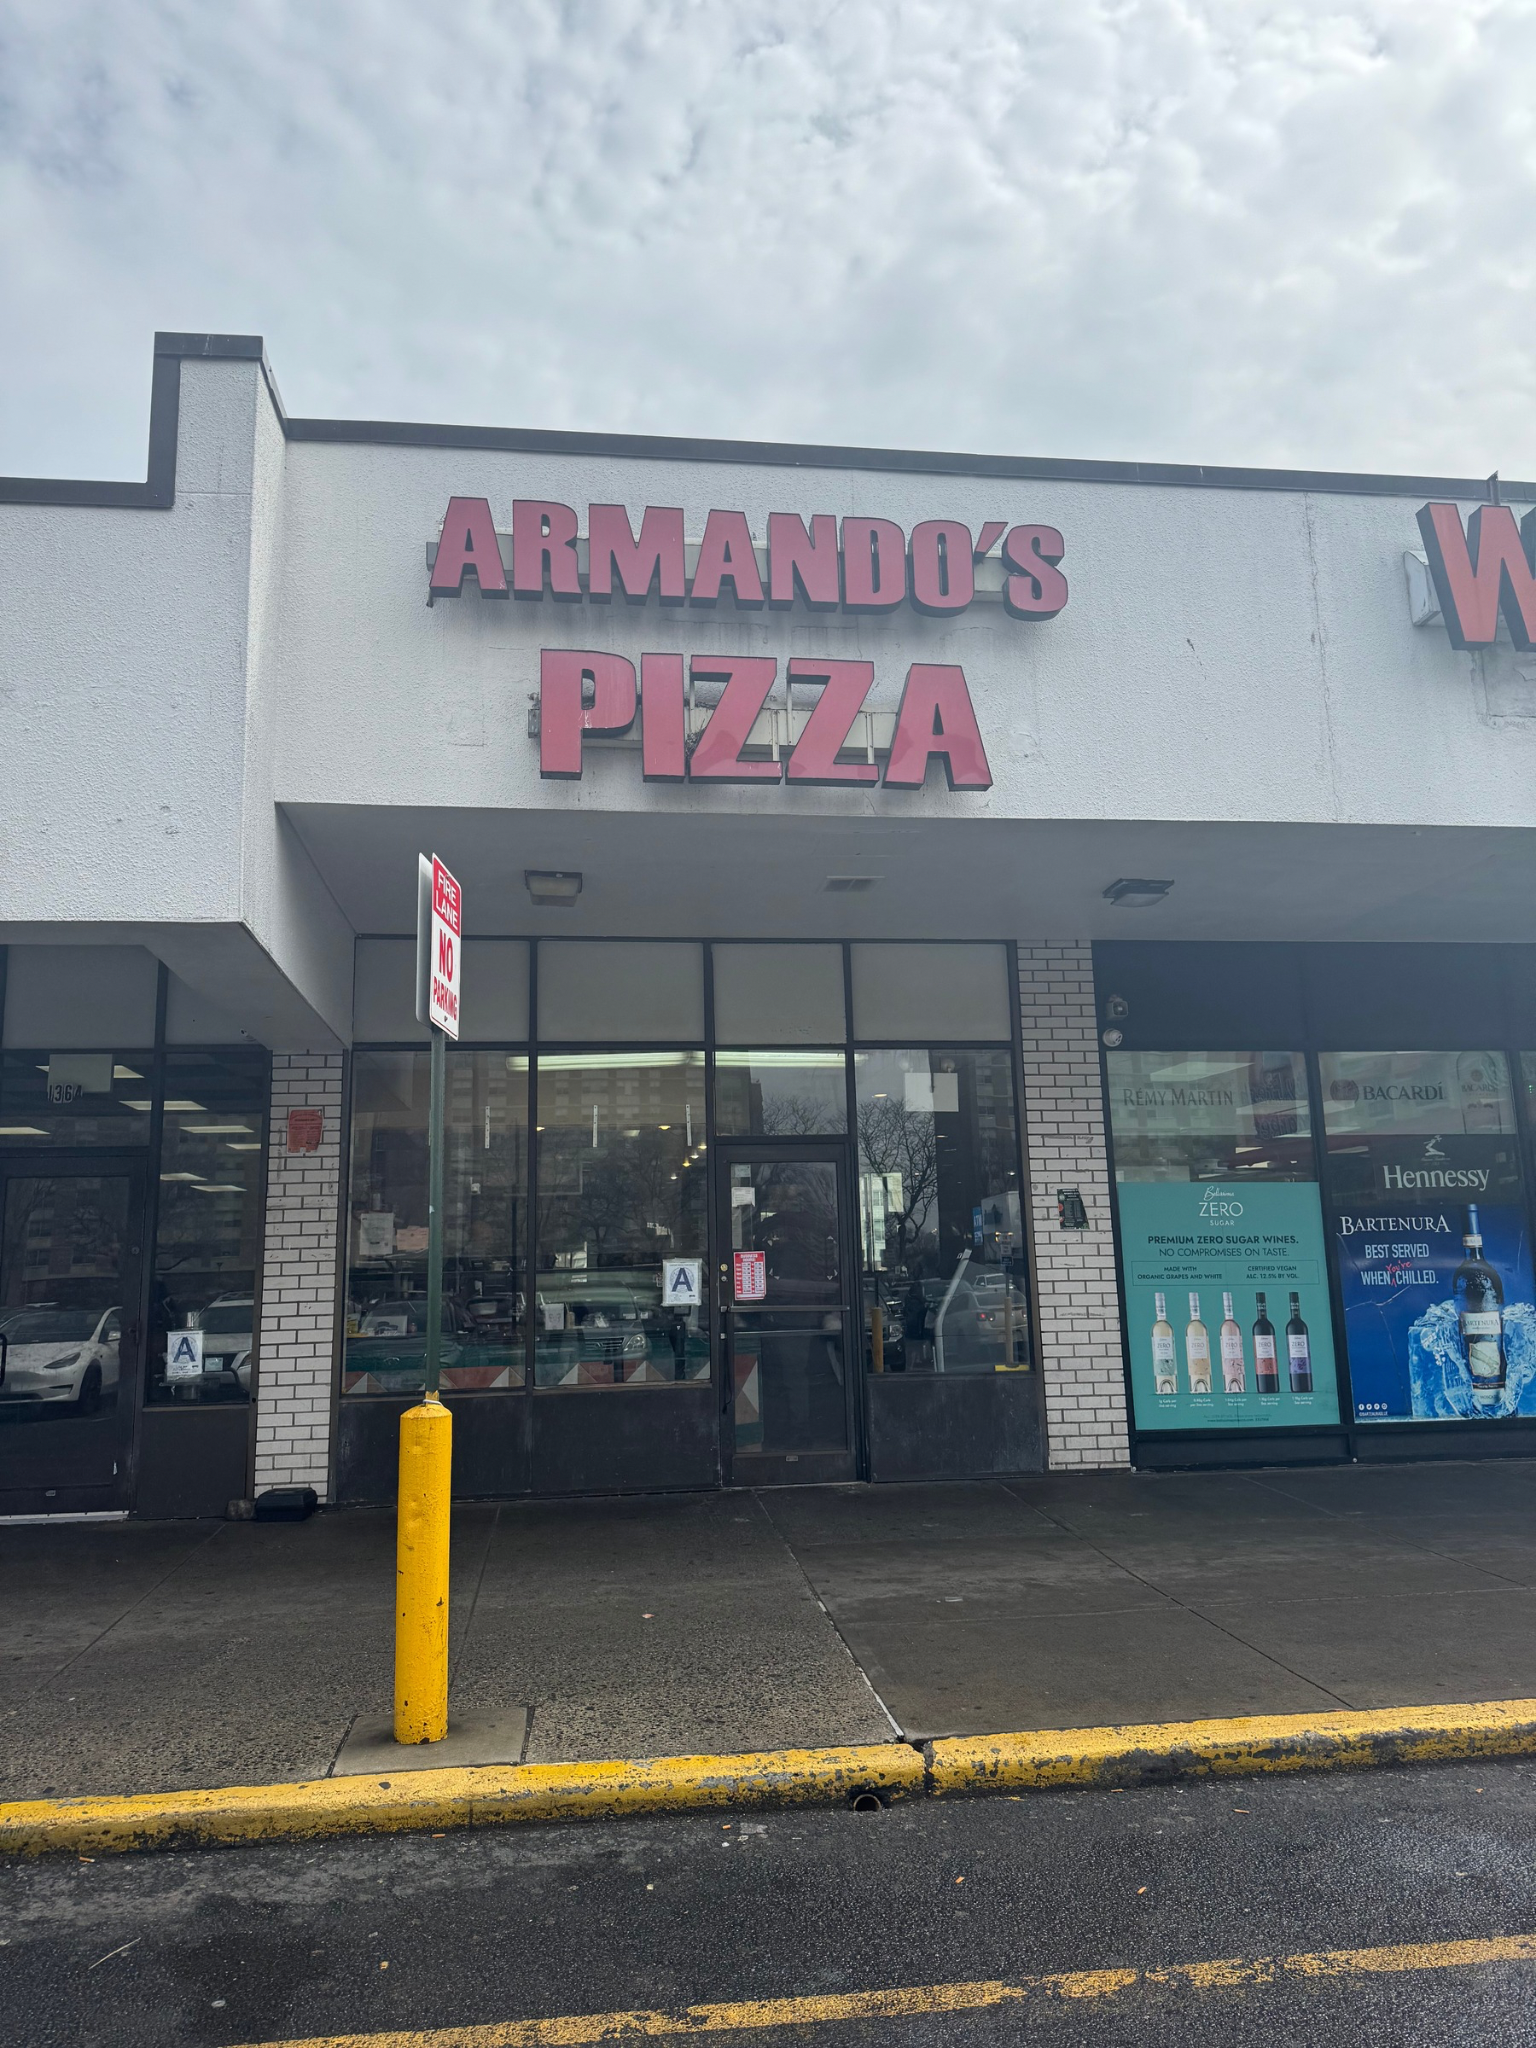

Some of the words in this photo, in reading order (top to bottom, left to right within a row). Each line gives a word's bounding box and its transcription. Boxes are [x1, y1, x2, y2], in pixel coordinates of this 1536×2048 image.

[430, 496, 1068, 621] ARMANDO'S
[540, 648, 993, 791] PIZZA
[437, 869, 457, 905] FIRE
[436, 889, 458, 930] LANE
[438, 928, 454, 983] NO
[433, 975, 457, 1021] PARKING
[1123, 1087, 1166, 1106] RÉMY
[1171, 1088, 1233, 1106] MARTIN
[1363, 1081, 1445, 1100] BACARDÍ
[1383, 1165, 1490, 1192] Hennessy
[1199, 1202, 1244, 1217] ZERO
[1340, 1214, 1452, 1235] BARTENURA
[1148, 1236, 1194, 1244] PREMIUM
[1197, 1236, 1223, 1244] ZERO
[1226, 1236, 1260, 1244] SUGAR
[1263, 1235, 1299, 1244] WINES.
[1365, 1244, 1389, 1258] BEST
[1392, 1243, 1429, 1258] SERVED
[1159, 1249, 1175, 1257] NO
[1177, 1248, 1242, 1257] COMPROMISES
[1244, 1248, 1260, 1257] ON
[1263, 1248, 1290, 1257] TASTE.
[671, 1267, 693, 1292] A
[1361, 1271, 1390, 1285] WHEN
[1395, 1270, 1439, 1285] CHILLED.
[172, 1336, 196, 1363] A
